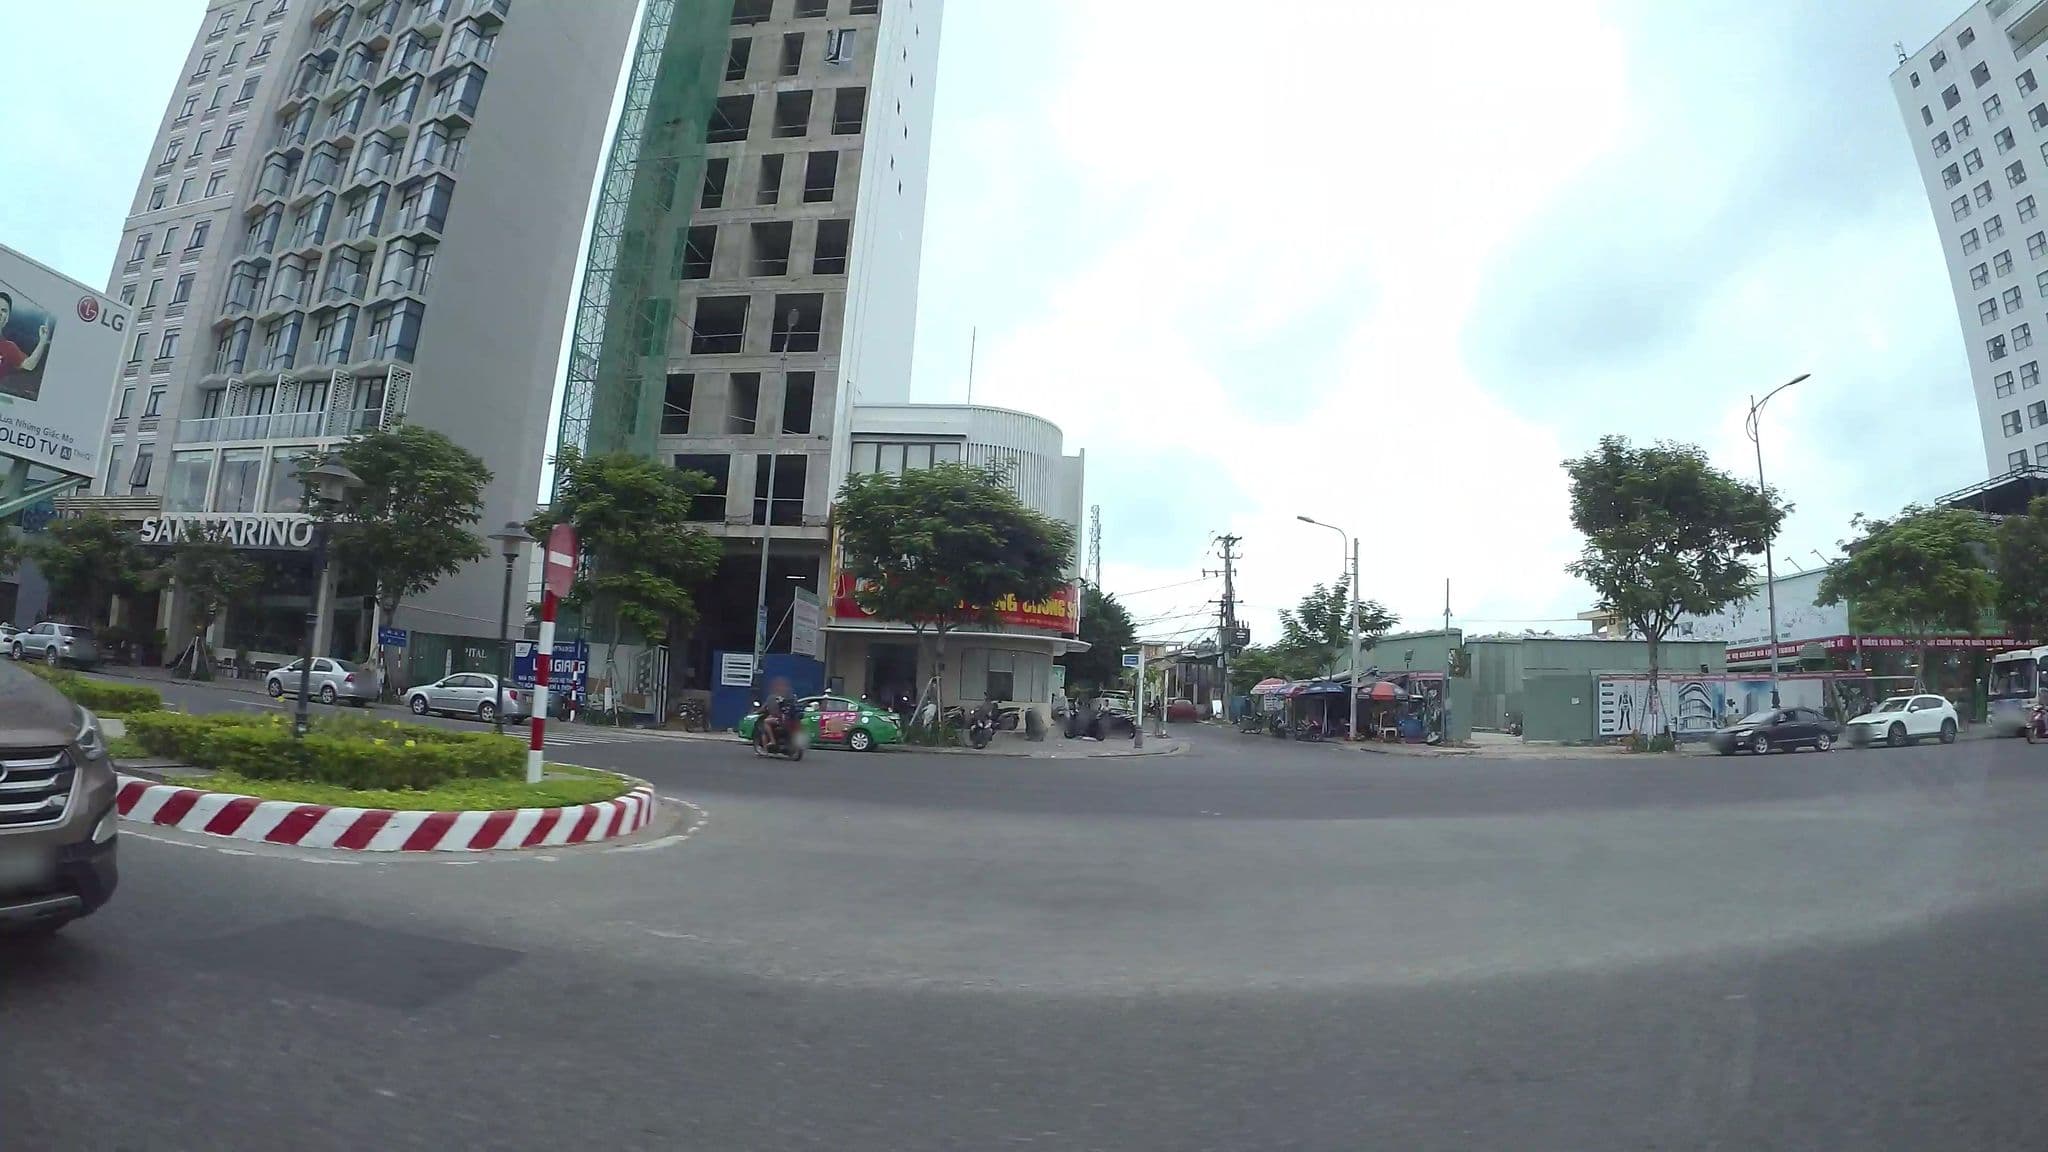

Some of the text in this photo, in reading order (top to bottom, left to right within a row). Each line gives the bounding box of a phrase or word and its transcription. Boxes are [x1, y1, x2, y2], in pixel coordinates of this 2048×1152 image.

[100, 308, 125, 332] LG
[0, 427, 36, 449] OLED
[40, 438, 58, 455] TV
[140, 516, 194, 544] SAN
